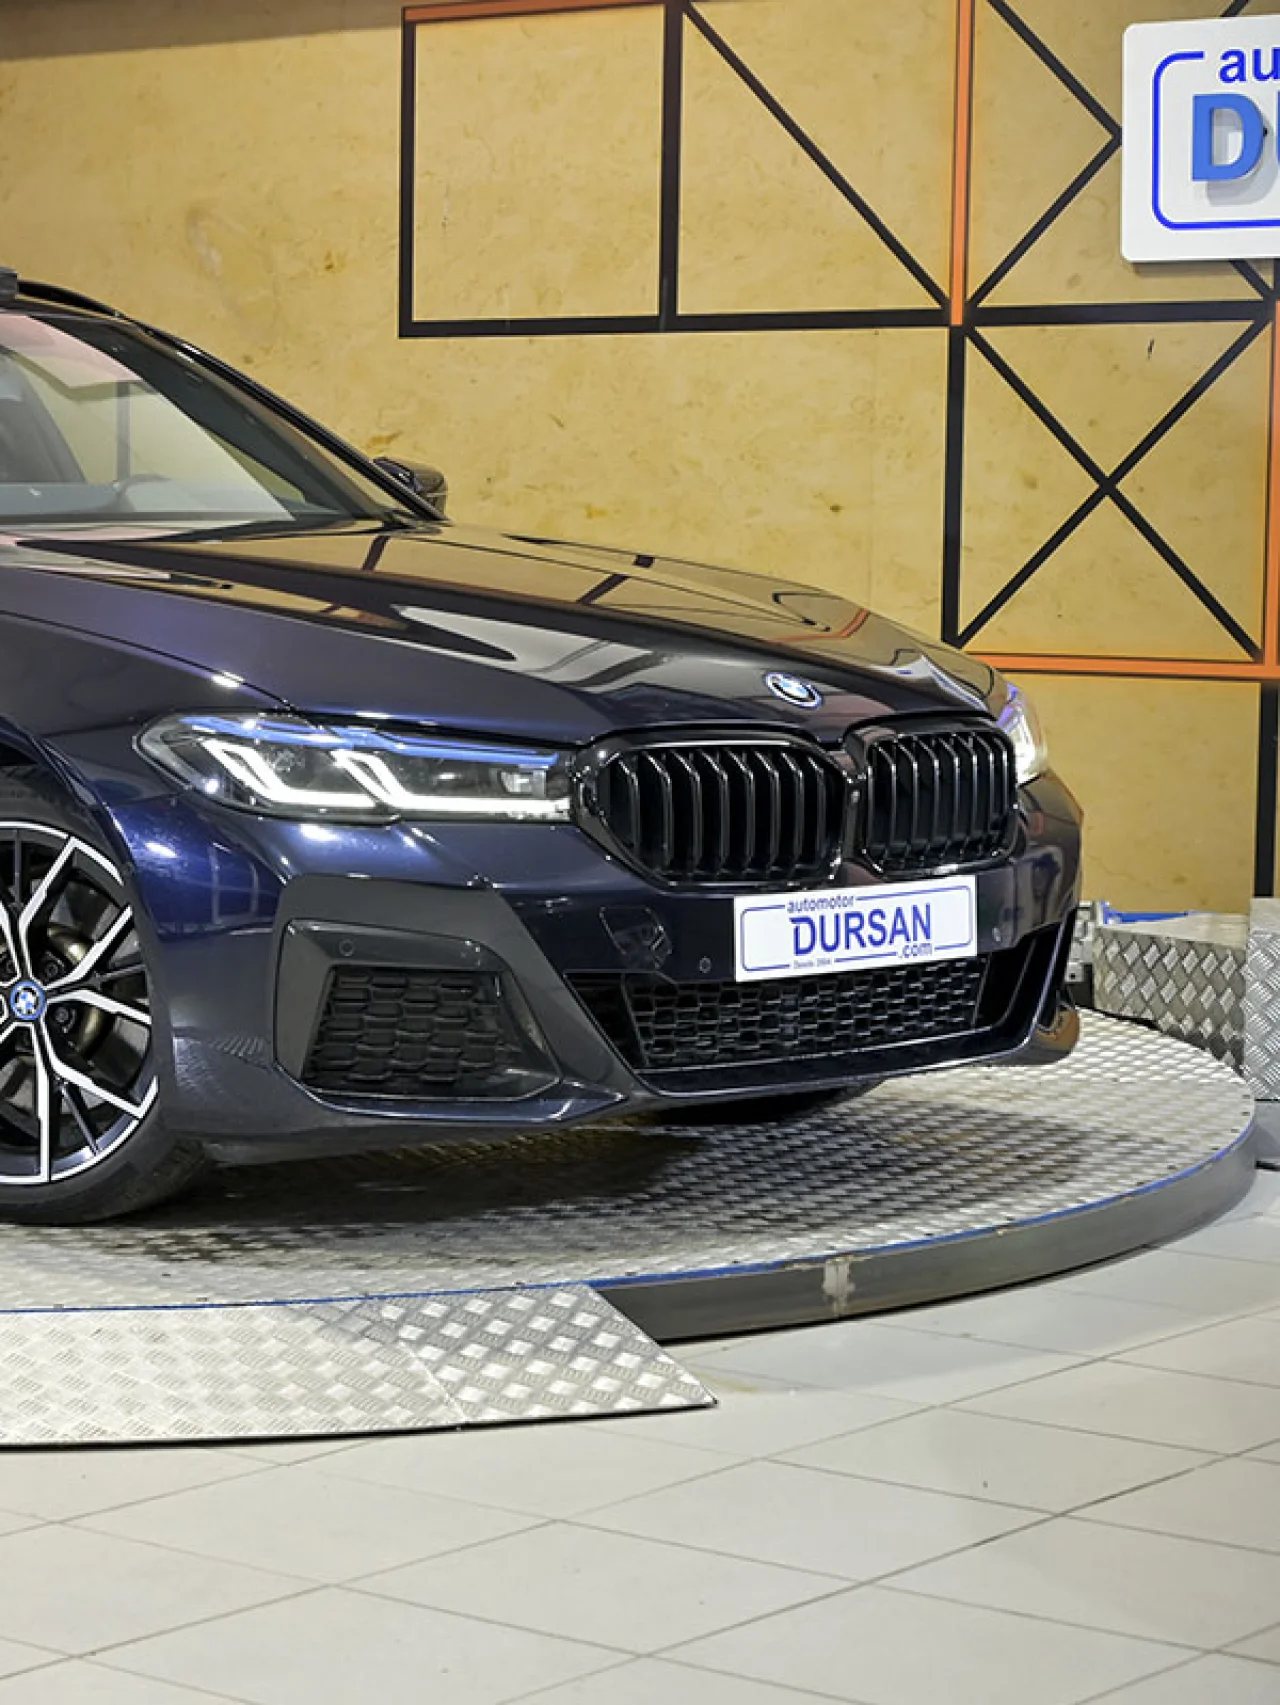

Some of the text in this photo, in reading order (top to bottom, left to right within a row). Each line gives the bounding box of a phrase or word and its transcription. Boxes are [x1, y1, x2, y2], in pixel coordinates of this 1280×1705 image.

[1219, 47, 1280, 83] au
[1192, 89, 1280, 181] D
[787, 896, 854, 913] automotor
[789, 904, 931, 956] DURSAN
[898, 942, 933, 959] .com
